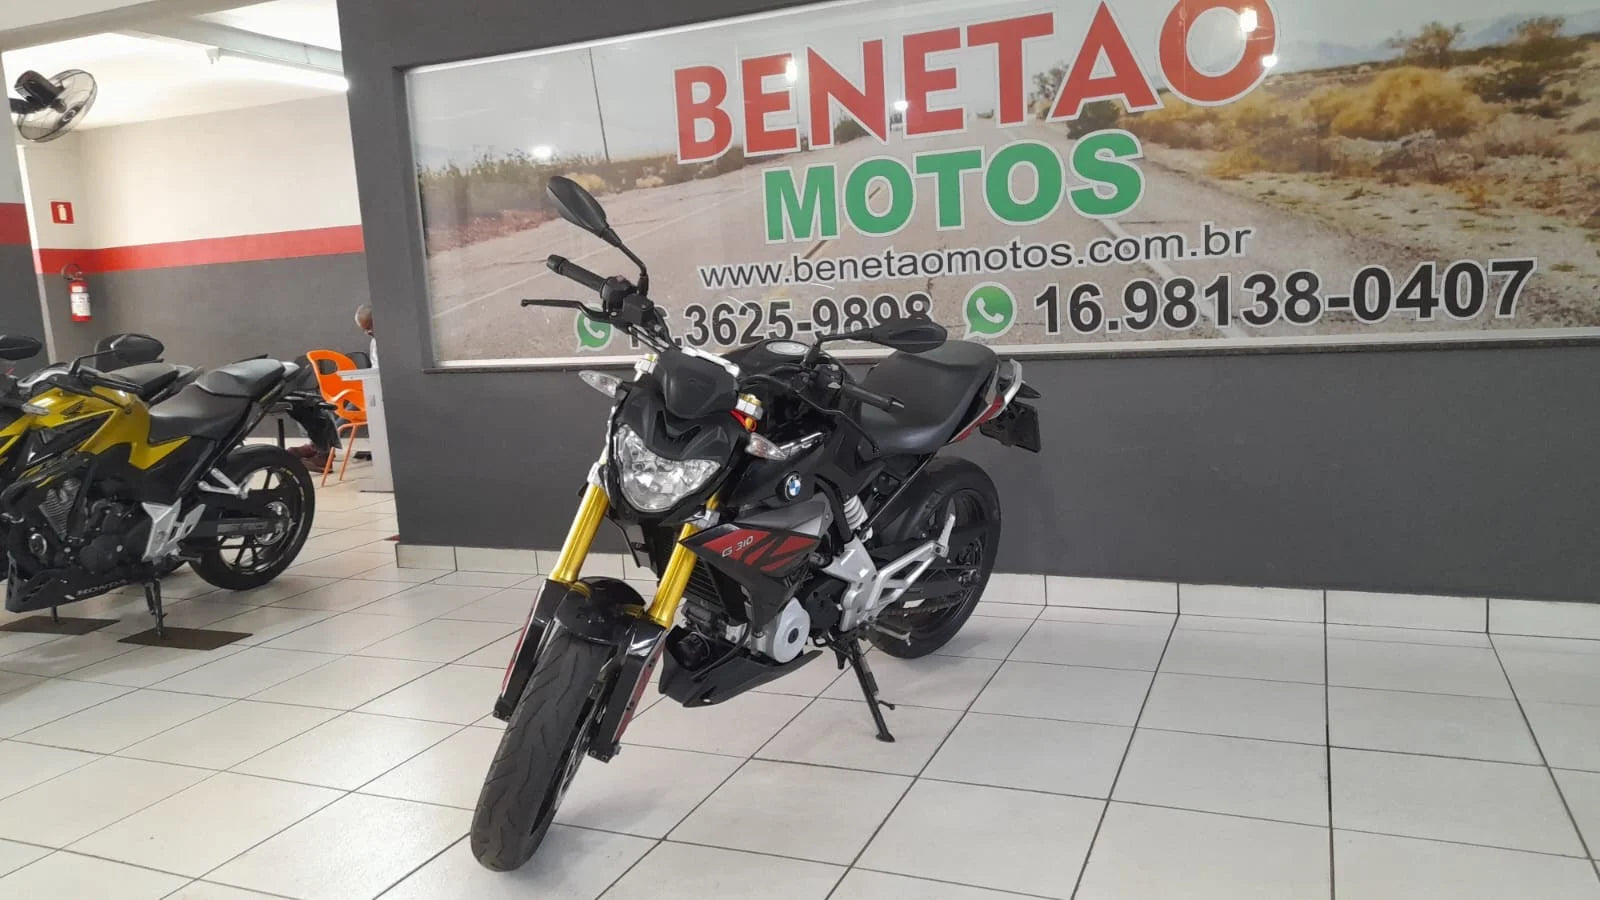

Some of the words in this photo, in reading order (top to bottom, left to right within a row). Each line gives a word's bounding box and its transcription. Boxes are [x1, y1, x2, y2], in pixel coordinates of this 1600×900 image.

[673, 0, 1276, 162] BENETAO
[763, 132, 1145, 242] MOTOS
[700, 225, 1252, 288] www.benetaomotos.com.br
[629, 293, 931, 348] .3625-9898
[1035, 260, 1535, 333] 16.98138-0407
[721, 546, 733, 558] G
[735, 535, 754, 552] 310
